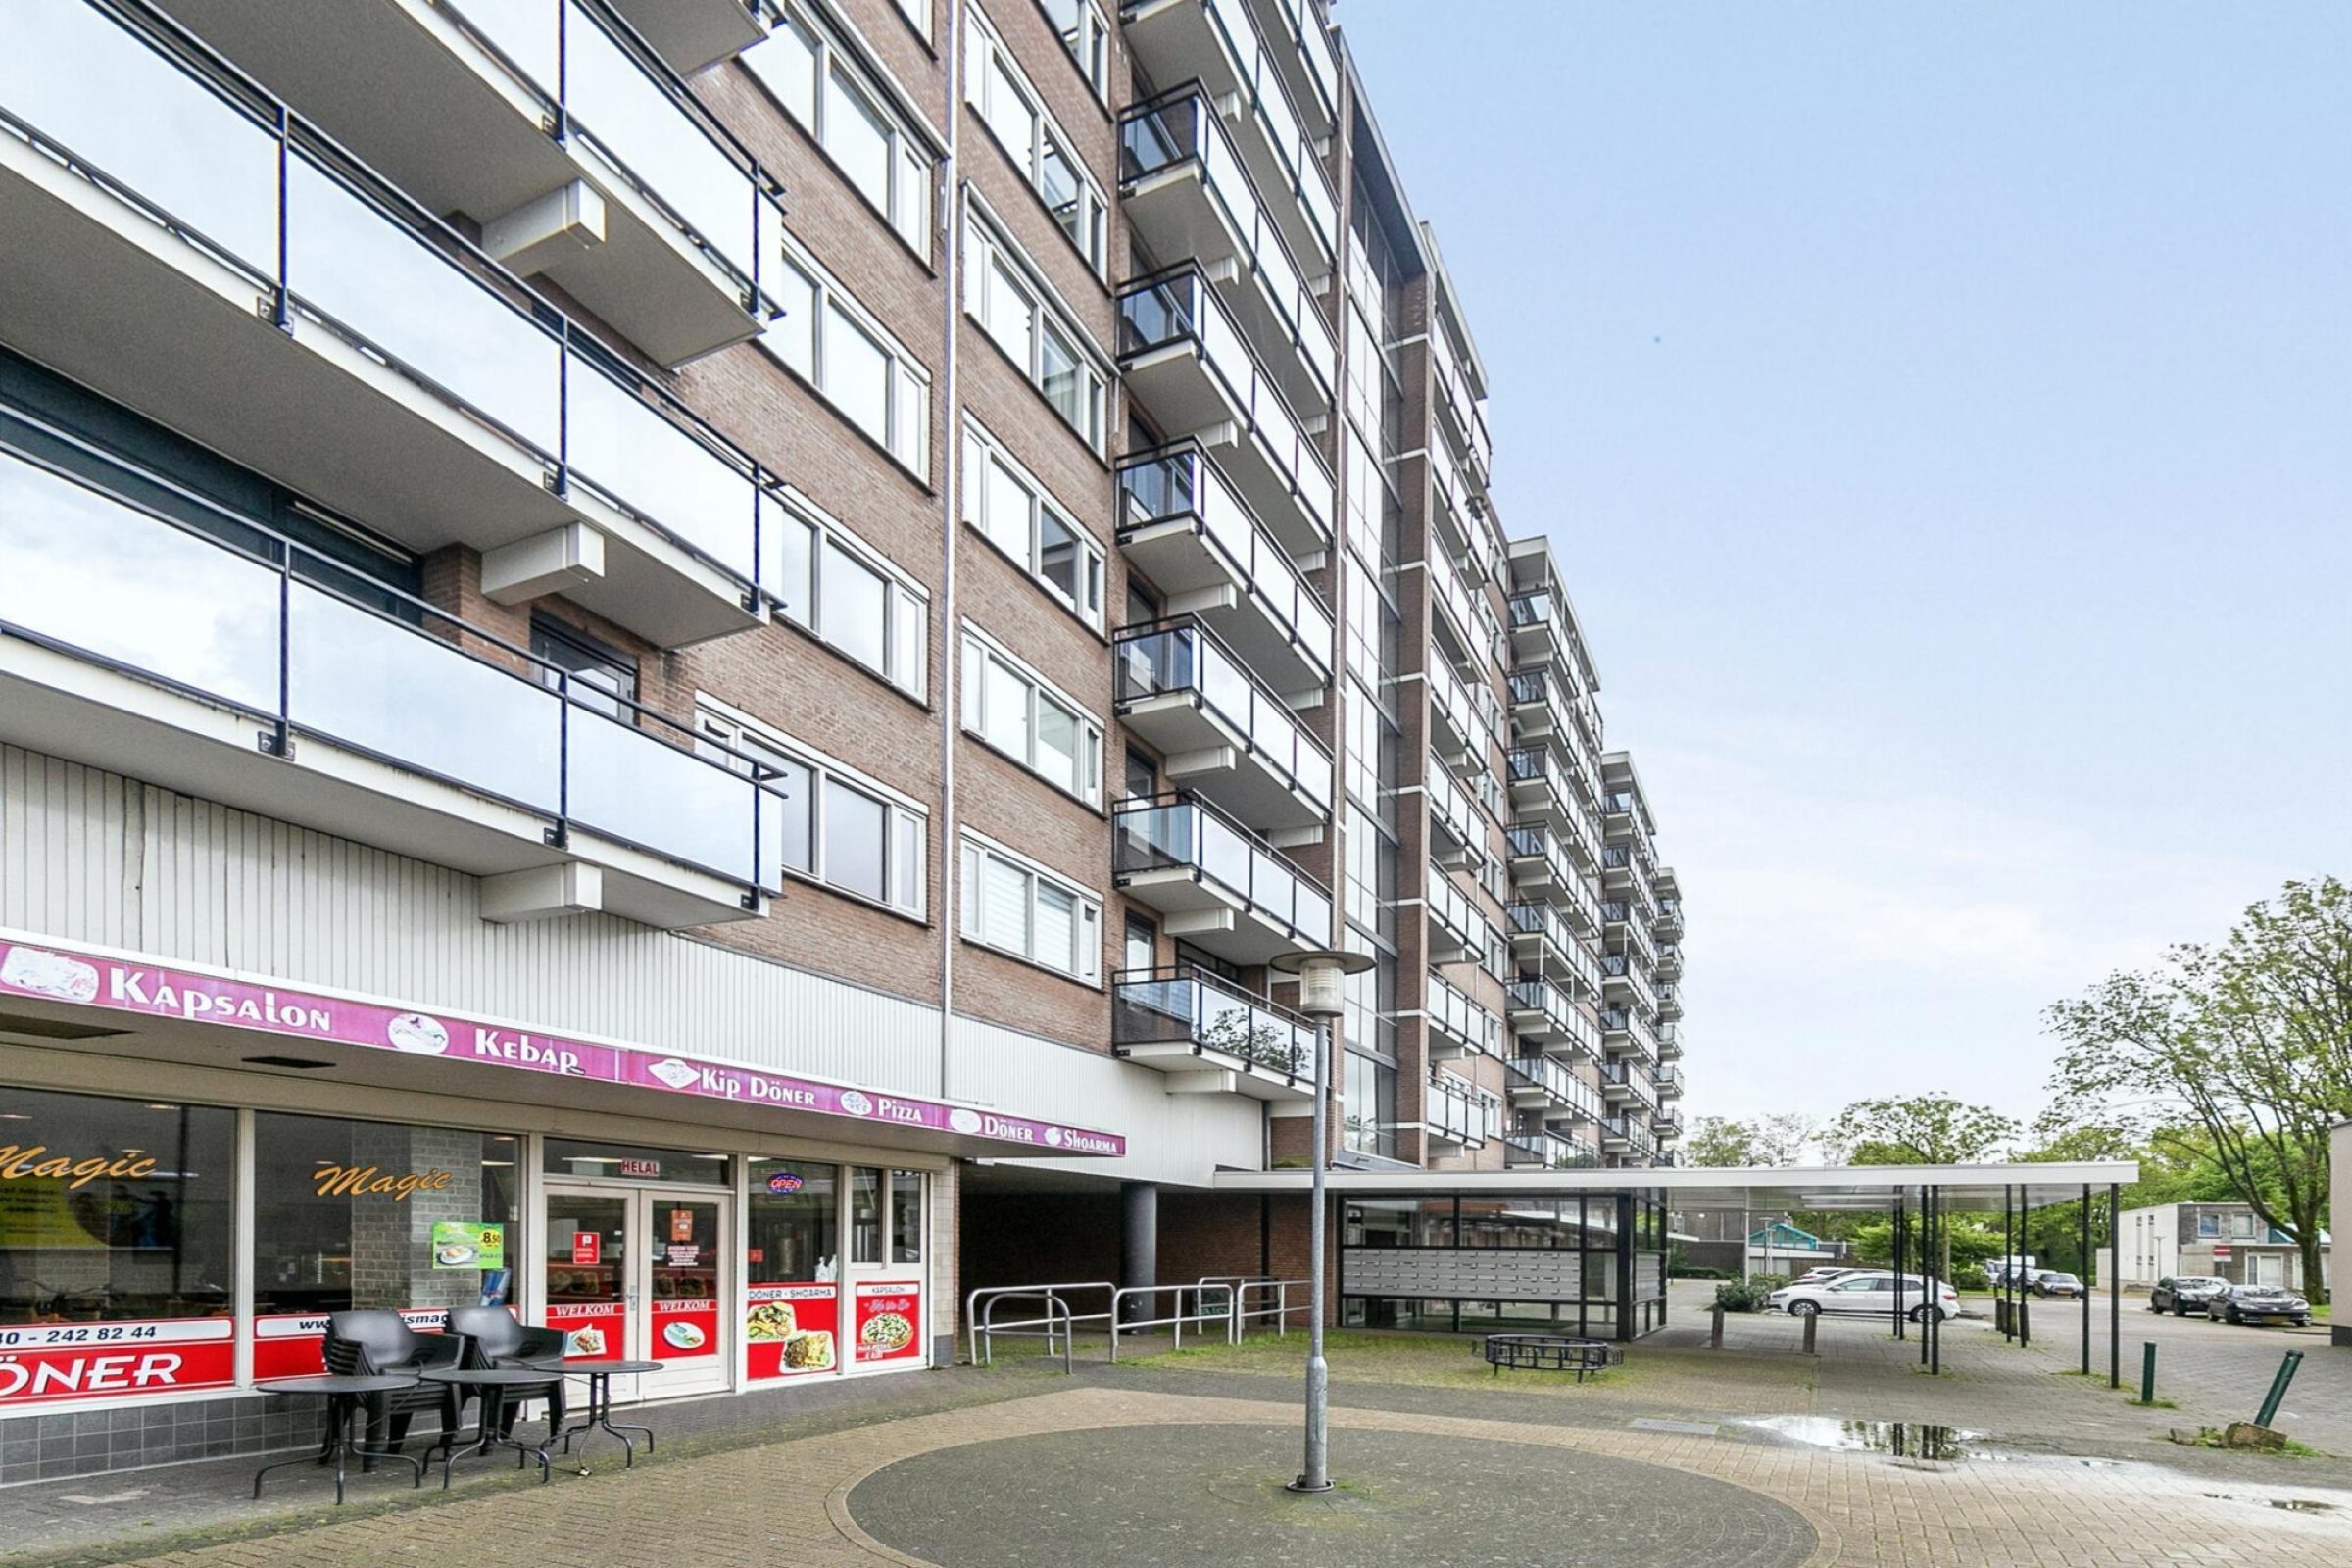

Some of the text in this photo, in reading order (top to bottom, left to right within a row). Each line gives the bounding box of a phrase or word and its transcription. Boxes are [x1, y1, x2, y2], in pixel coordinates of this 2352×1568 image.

[702, 1067, 741, 1099] Kip
[621, 1159, 660, 1176] HELAL
[313, 1165, 452, 1201] Magic
[769, 1178, 803, 1191] OPEN
[789, 1288, 833, 1298] SHOARMA
[556, 1304, 614, 1317] WELKOM
[658, 1300, 710, 1312] WELKOM
[46, 1328, 89, 1343] 242
[97, 1327, 123, 1341] 82
[130, 1325, 157, 1339] 44
